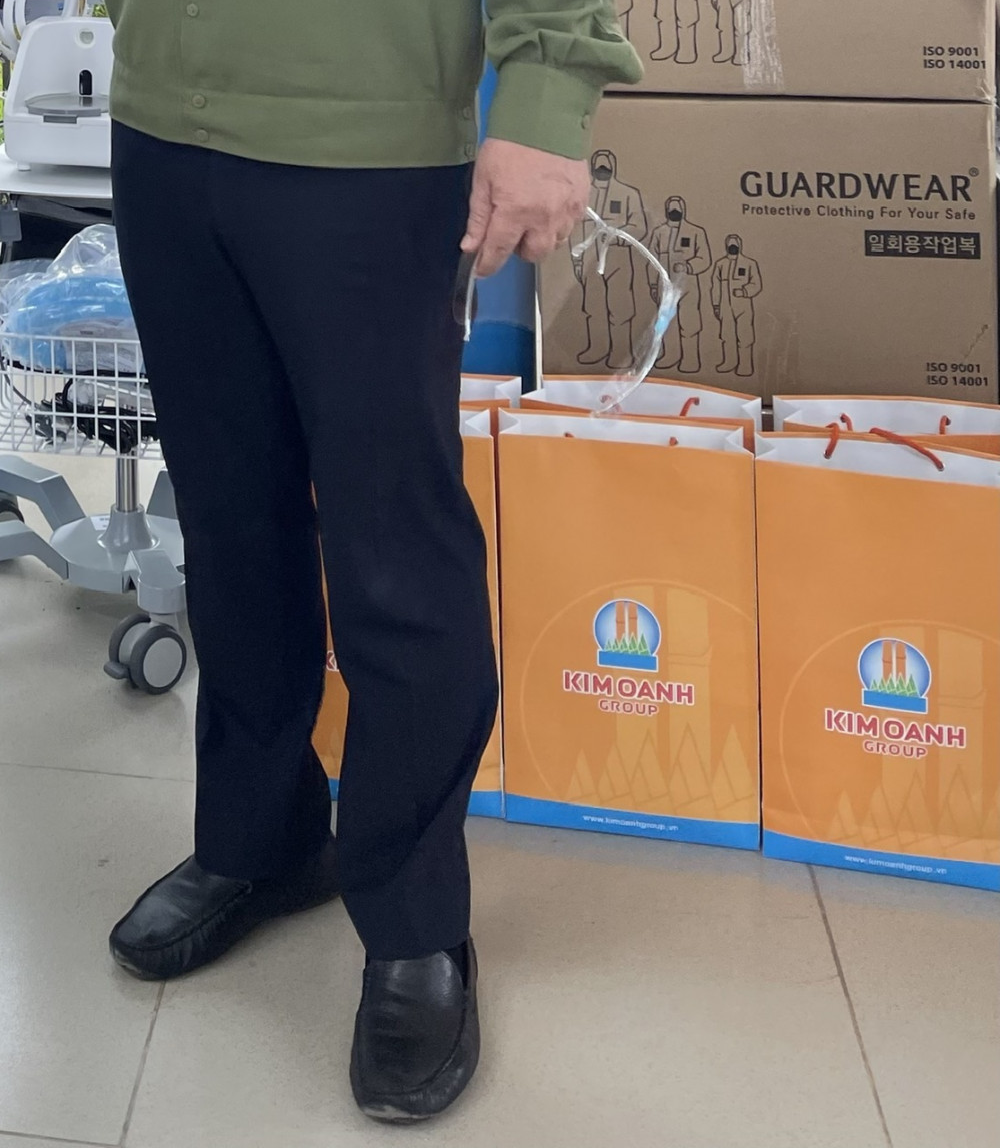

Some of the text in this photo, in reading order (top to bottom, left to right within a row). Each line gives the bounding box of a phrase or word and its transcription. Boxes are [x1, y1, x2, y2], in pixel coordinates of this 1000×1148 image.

[923, 45, 979, 57] ISO 9001
[923, 58, 986, 70] ISO 14001
[741, 204, 976, 220] Protective Clothing For Your Safe
[868, 234, 977, 256] 일회용작업복
[926, 362, 981, 373] ISO 9001
[927, 375, 989, 387] ISO 14001
[563, 670, 695, 706] KIM OANH
[598, 699, 659, 717] GROUP
[825, 708, 966, 748] KIM OANH
[863, 739, 929, 758] GROUP
